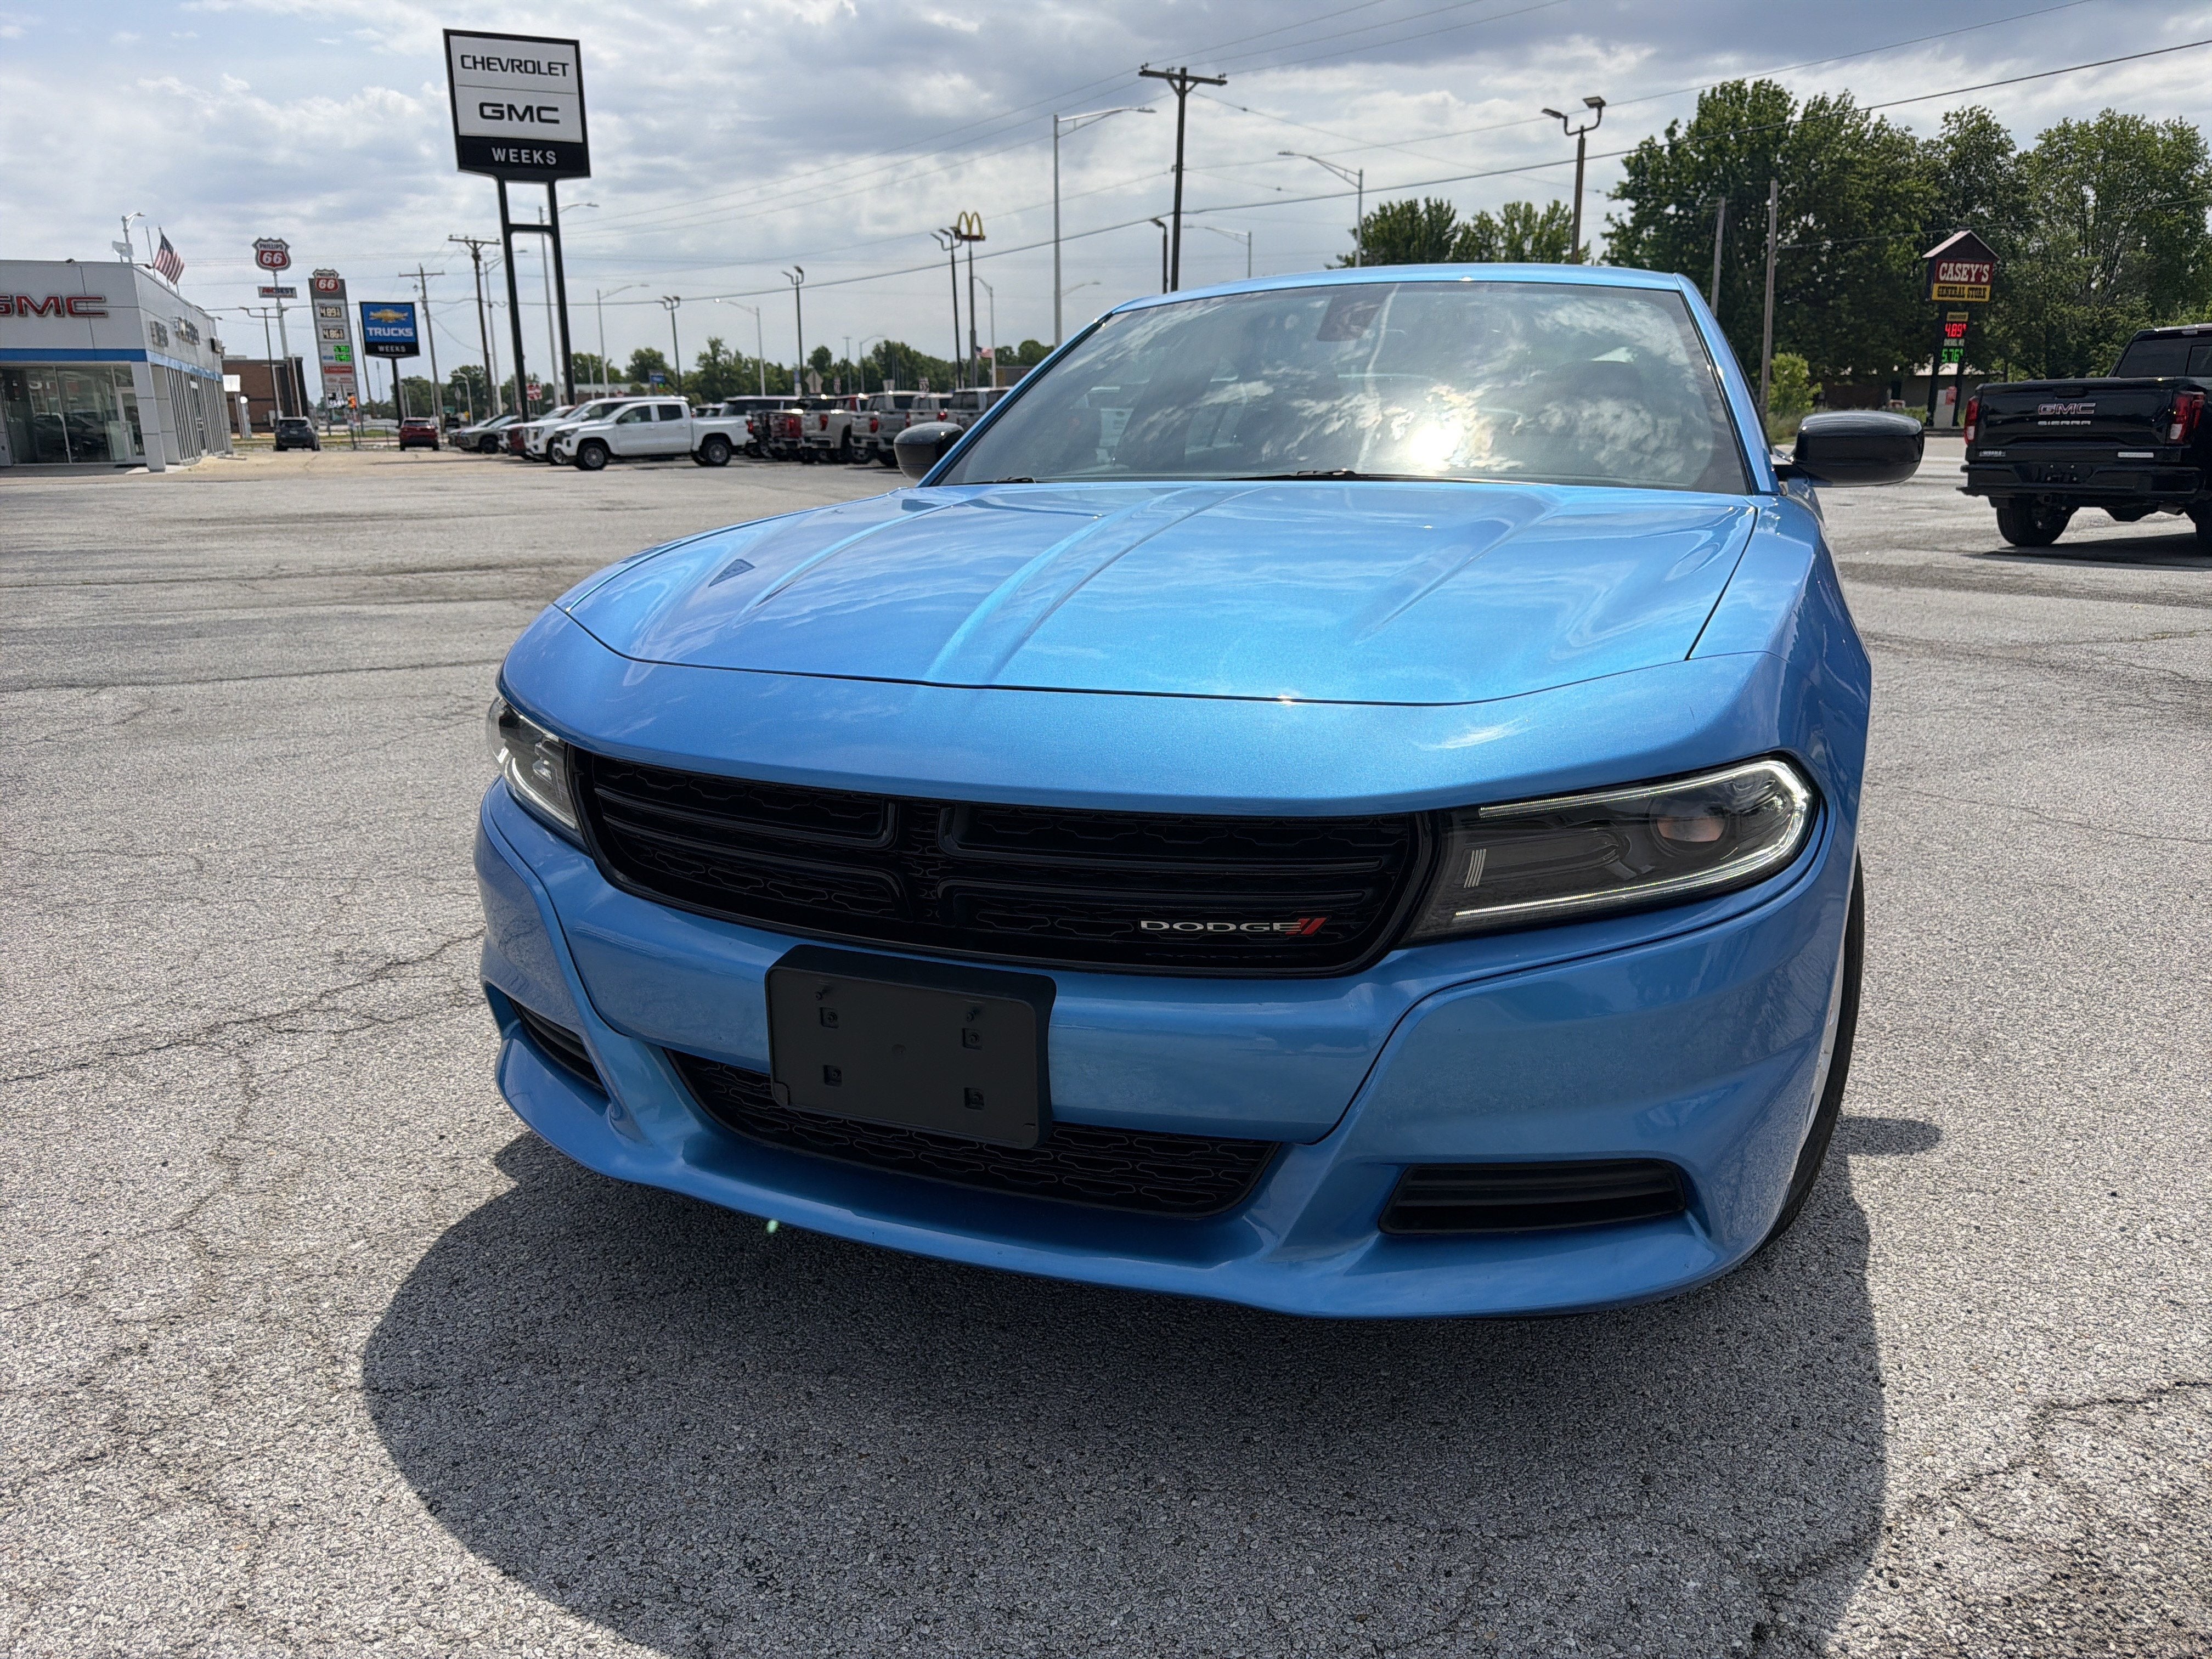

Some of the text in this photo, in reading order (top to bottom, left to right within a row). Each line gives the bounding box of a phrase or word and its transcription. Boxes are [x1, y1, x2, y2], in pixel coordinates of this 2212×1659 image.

[460, 54, 569, 77] CHEVROLET
[478, 102, 560, 125] GMC
[492, 146, 557, 165] WEEKS
[263, 252, 283, 264] 66
[1939, 262, 1990, 283] CASEY'S
[318, 279, 335, 289] 66
[1937, 285, 1987, 299] GENERAL STORE
[366, 327, 414, 337] TRUCKS
[377, 345, 406, 353] WEEKS
[2038, 402, 2096, 415] GMC
[1141, 920, 1302, 933] DODGE
